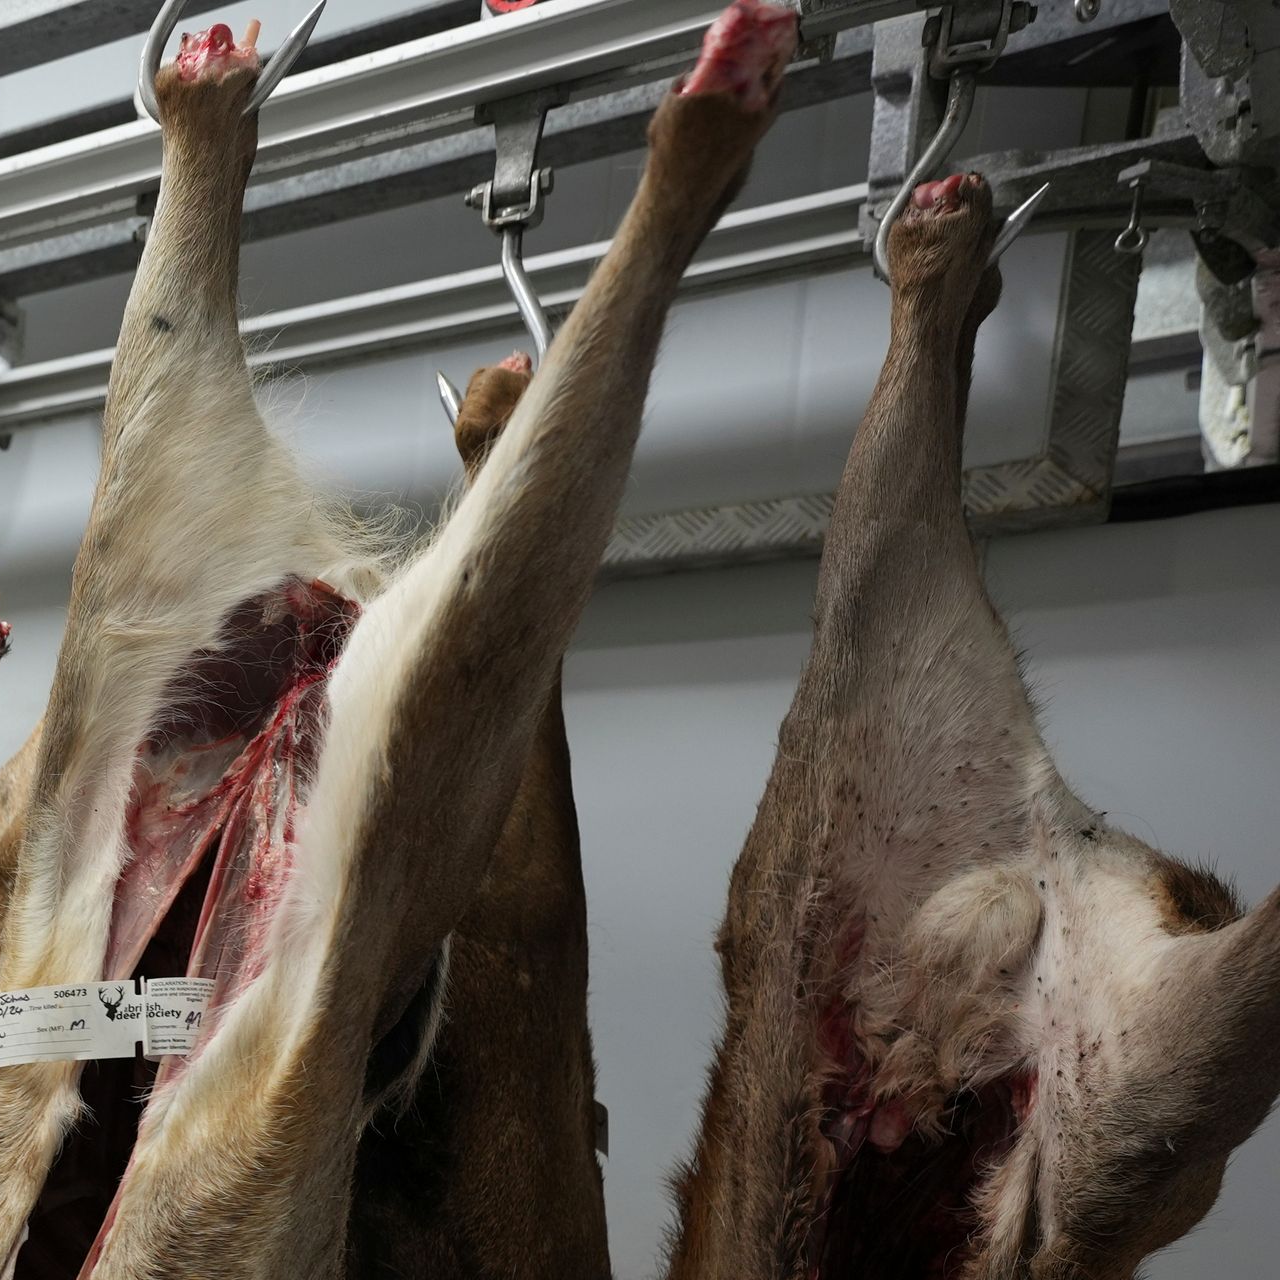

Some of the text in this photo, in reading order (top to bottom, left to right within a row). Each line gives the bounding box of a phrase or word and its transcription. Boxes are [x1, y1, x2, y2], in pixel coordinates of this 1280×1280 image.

[53, 988, 88, 999] 506473
[128, 1002, 161, 1012] briish
[115, 1011, 141, 1020] deer
